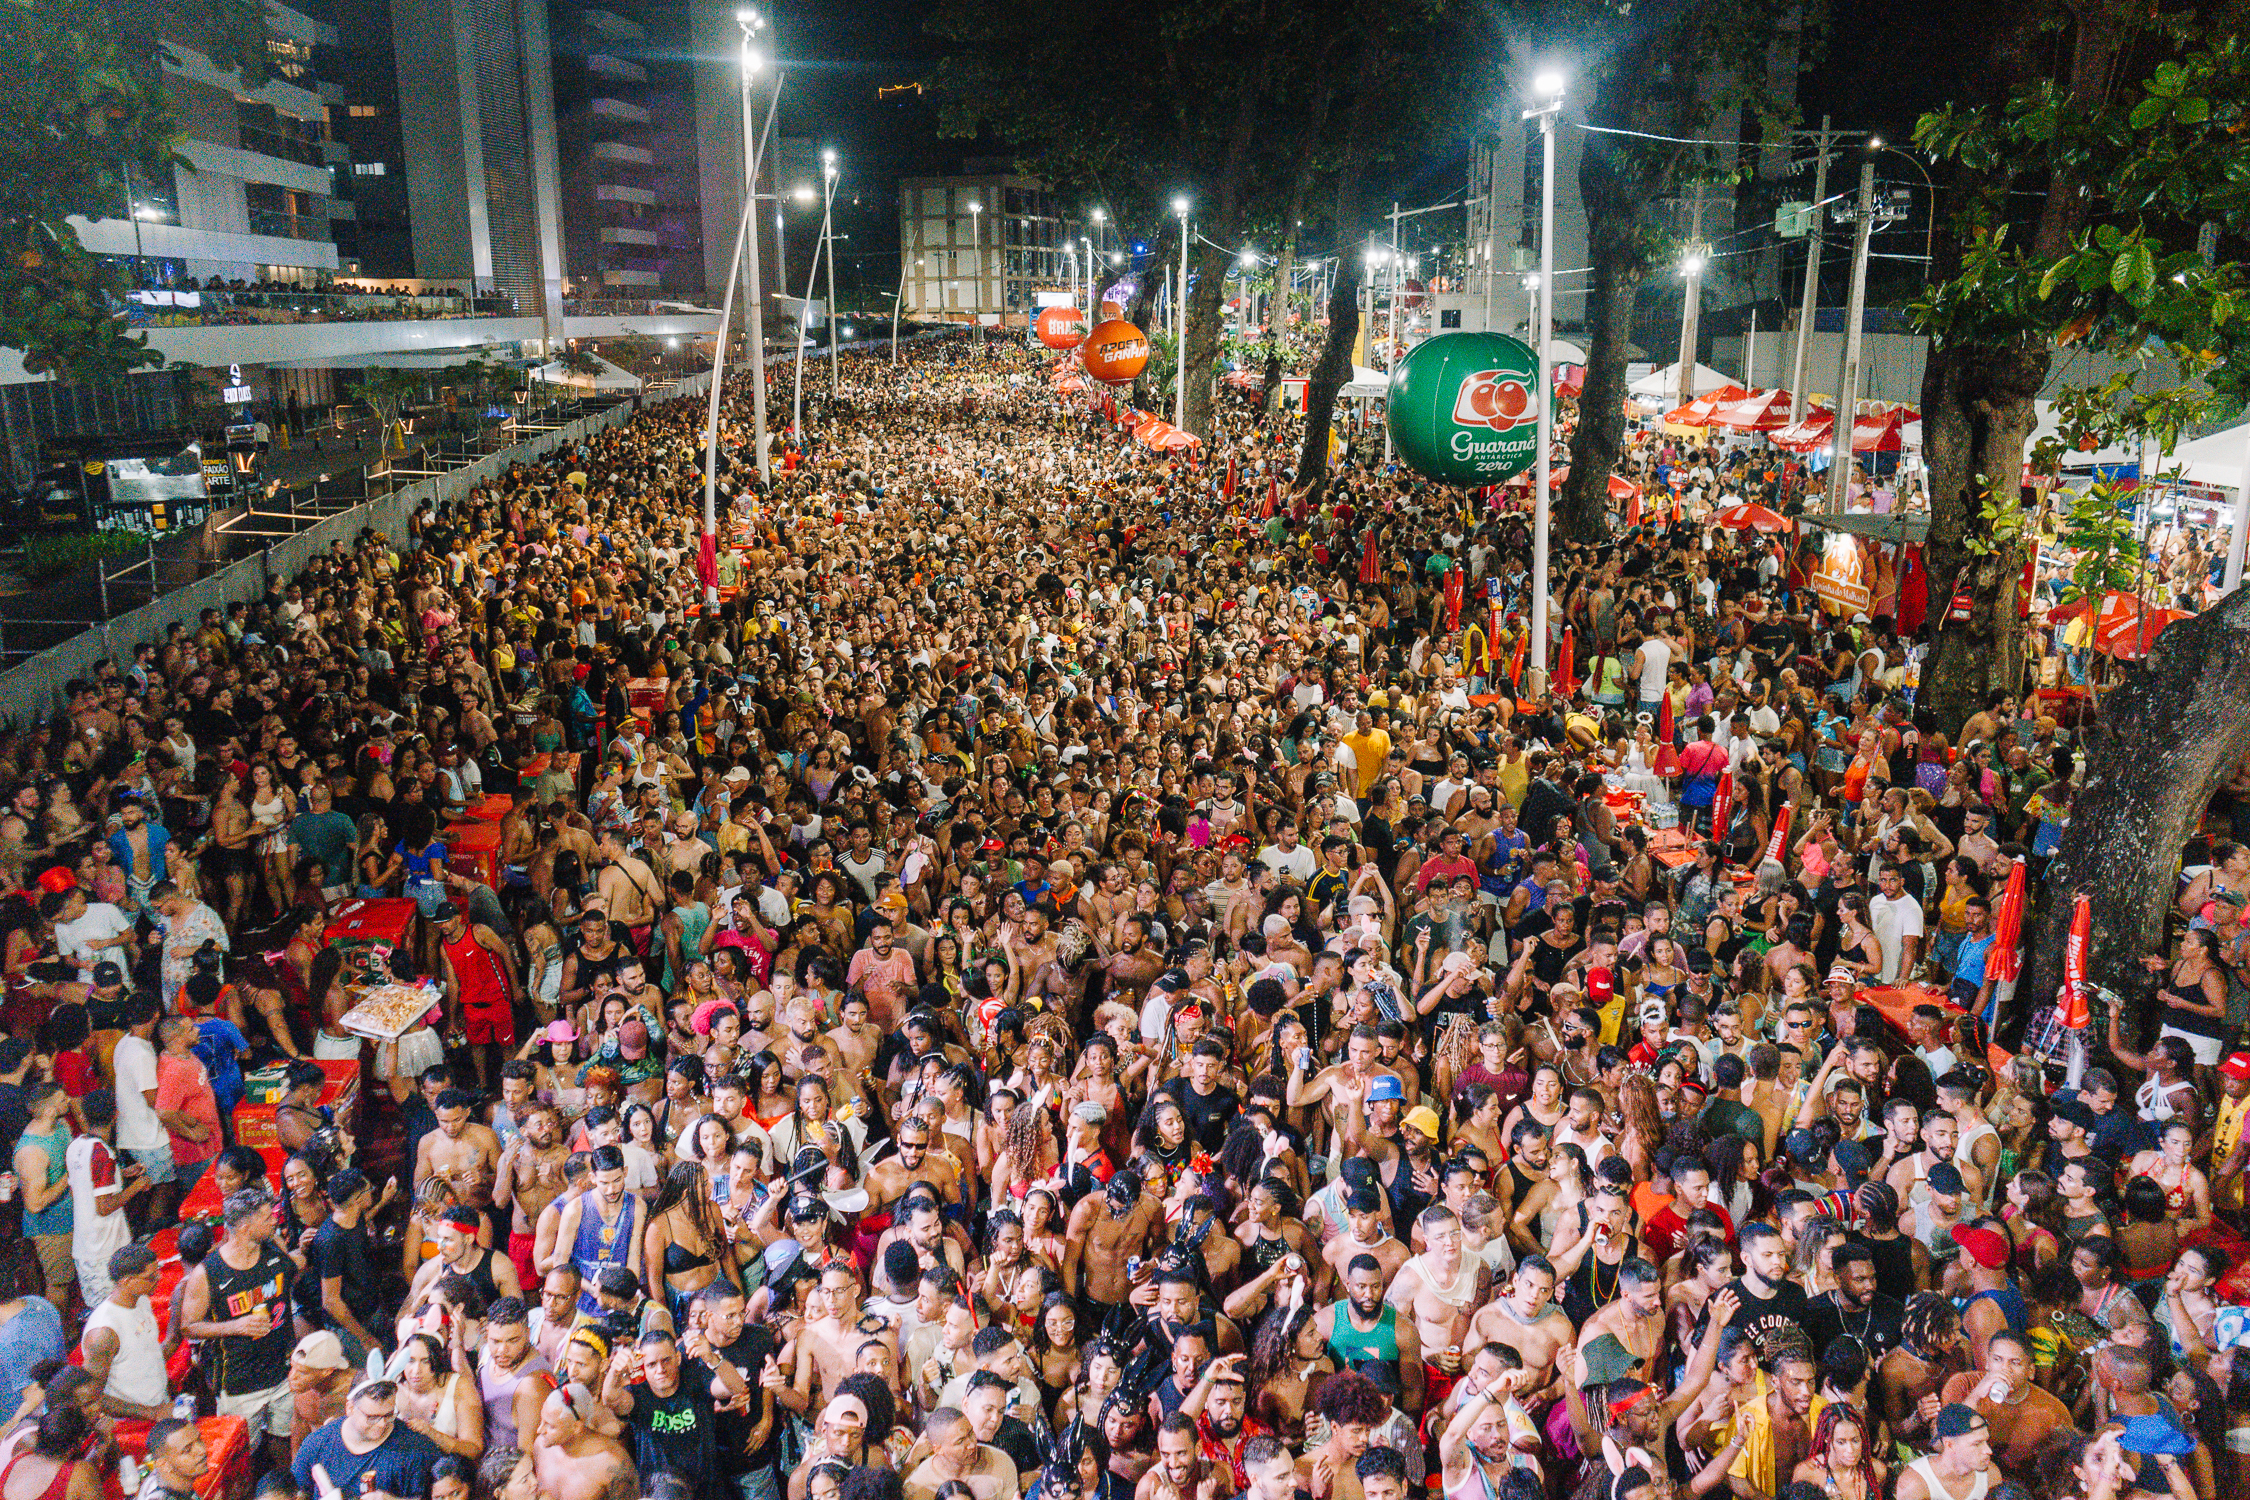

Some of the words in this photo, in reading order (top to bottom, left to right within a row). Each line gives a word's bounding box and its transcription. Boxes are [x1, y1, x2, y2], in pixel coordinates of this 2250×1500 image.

[1451, 431, 1537, 461] Guaraná
[1475, 461, 1513, 471] zero
[651, 1408, 696, 1431] BOSS
